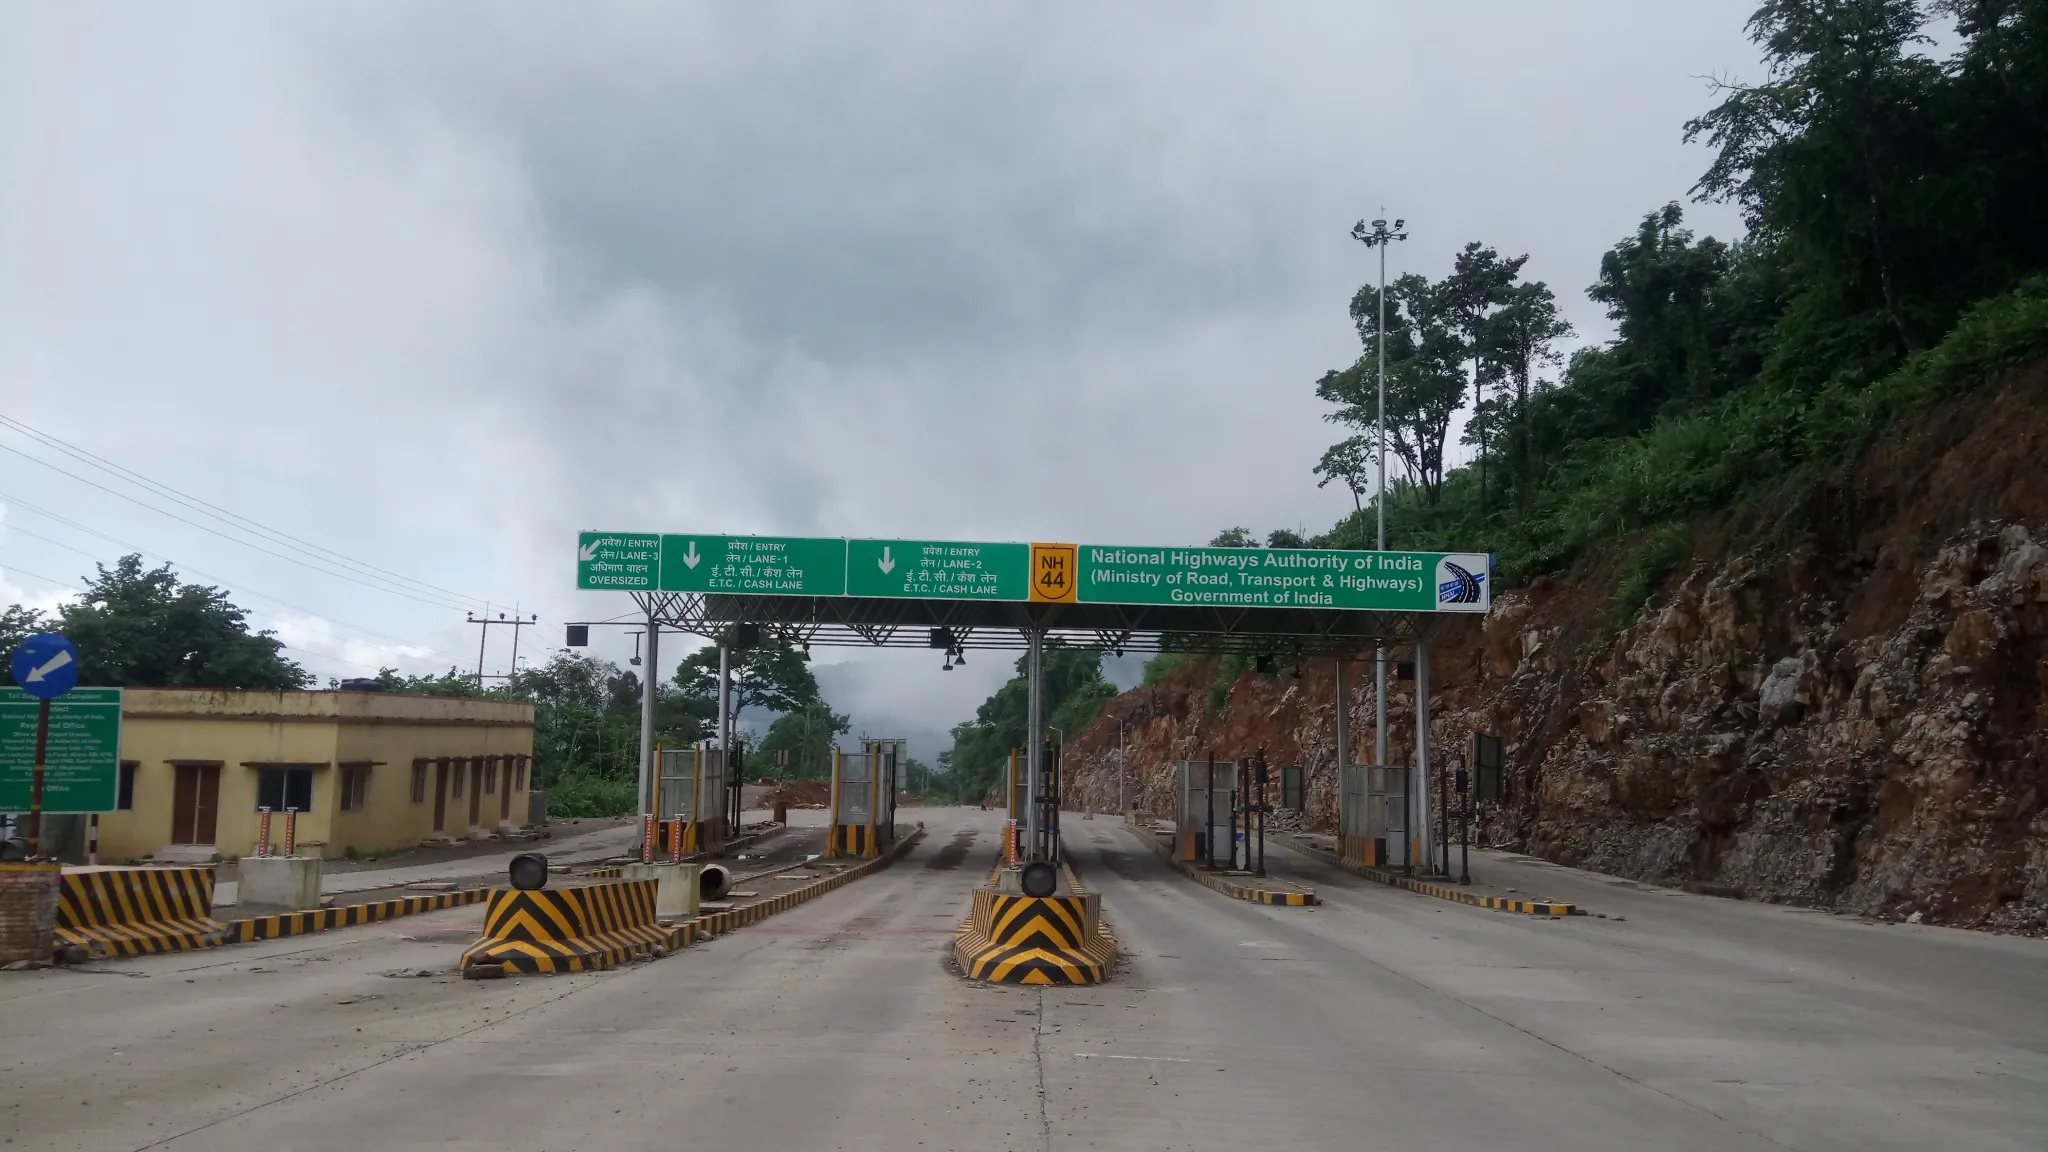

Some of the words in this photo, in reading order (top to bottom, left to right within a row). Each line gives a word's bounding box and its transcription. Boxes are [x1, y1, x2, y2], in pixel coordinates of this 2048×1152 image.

[601, 536, 621, 547] प्रवेश
[628, 540, 659, 548] ENTRY
[728, 540, 748, 551] प्रवेश
[755, 543, 786, 551] ENTRY
[600, 549, 615, 559] लेन
[922, 545, 942, 556] प्रवेश
[950, 548, 980, 556] ENTRY
[726, 552, 741, 562] लेन
[1091, 549, 1165, 565] National
[1171, 551, 1259, 569] Highways
[1263, 553, 1348, 572] Authority
[1354, 556, 1373, 570] of
[1378, 556, 1423, 571] India
[626, 564, 648, 573] वाहन
[920, 558, 935, 568] लेन
[1042, 556, 1064, 570] NH
[786, 566, 803, 578] लेन
[589, 575, 648, 585] OVERSIZED
[980, 572, 997, 584] लेन
[1040, 571, 1065, 588] 44
[1091, 569, 1161, 586] (Ministry
[1166, 572, 1183, 585] of
[1186, 572, 1233, 587] Road,
[1238, 572, 1316, 588] Transport
[1322, 575, 1334, 587] &
[1340, 575, 1423, 592] Highways)
[709, 579, 736, 588] E.T.C.
[744, 580, 773, 589] CASH
[775, 581, 803, 589] LANE
[903, 584, 931, 592] E.T.C.
[939, 585, 967, 594] CASH
[970, 586, 997, 594] LANE
[1171, 588, 1269, 604] Government
[1273, 590, 1289, 604] of
[1294, 591, 1333, 605] India
